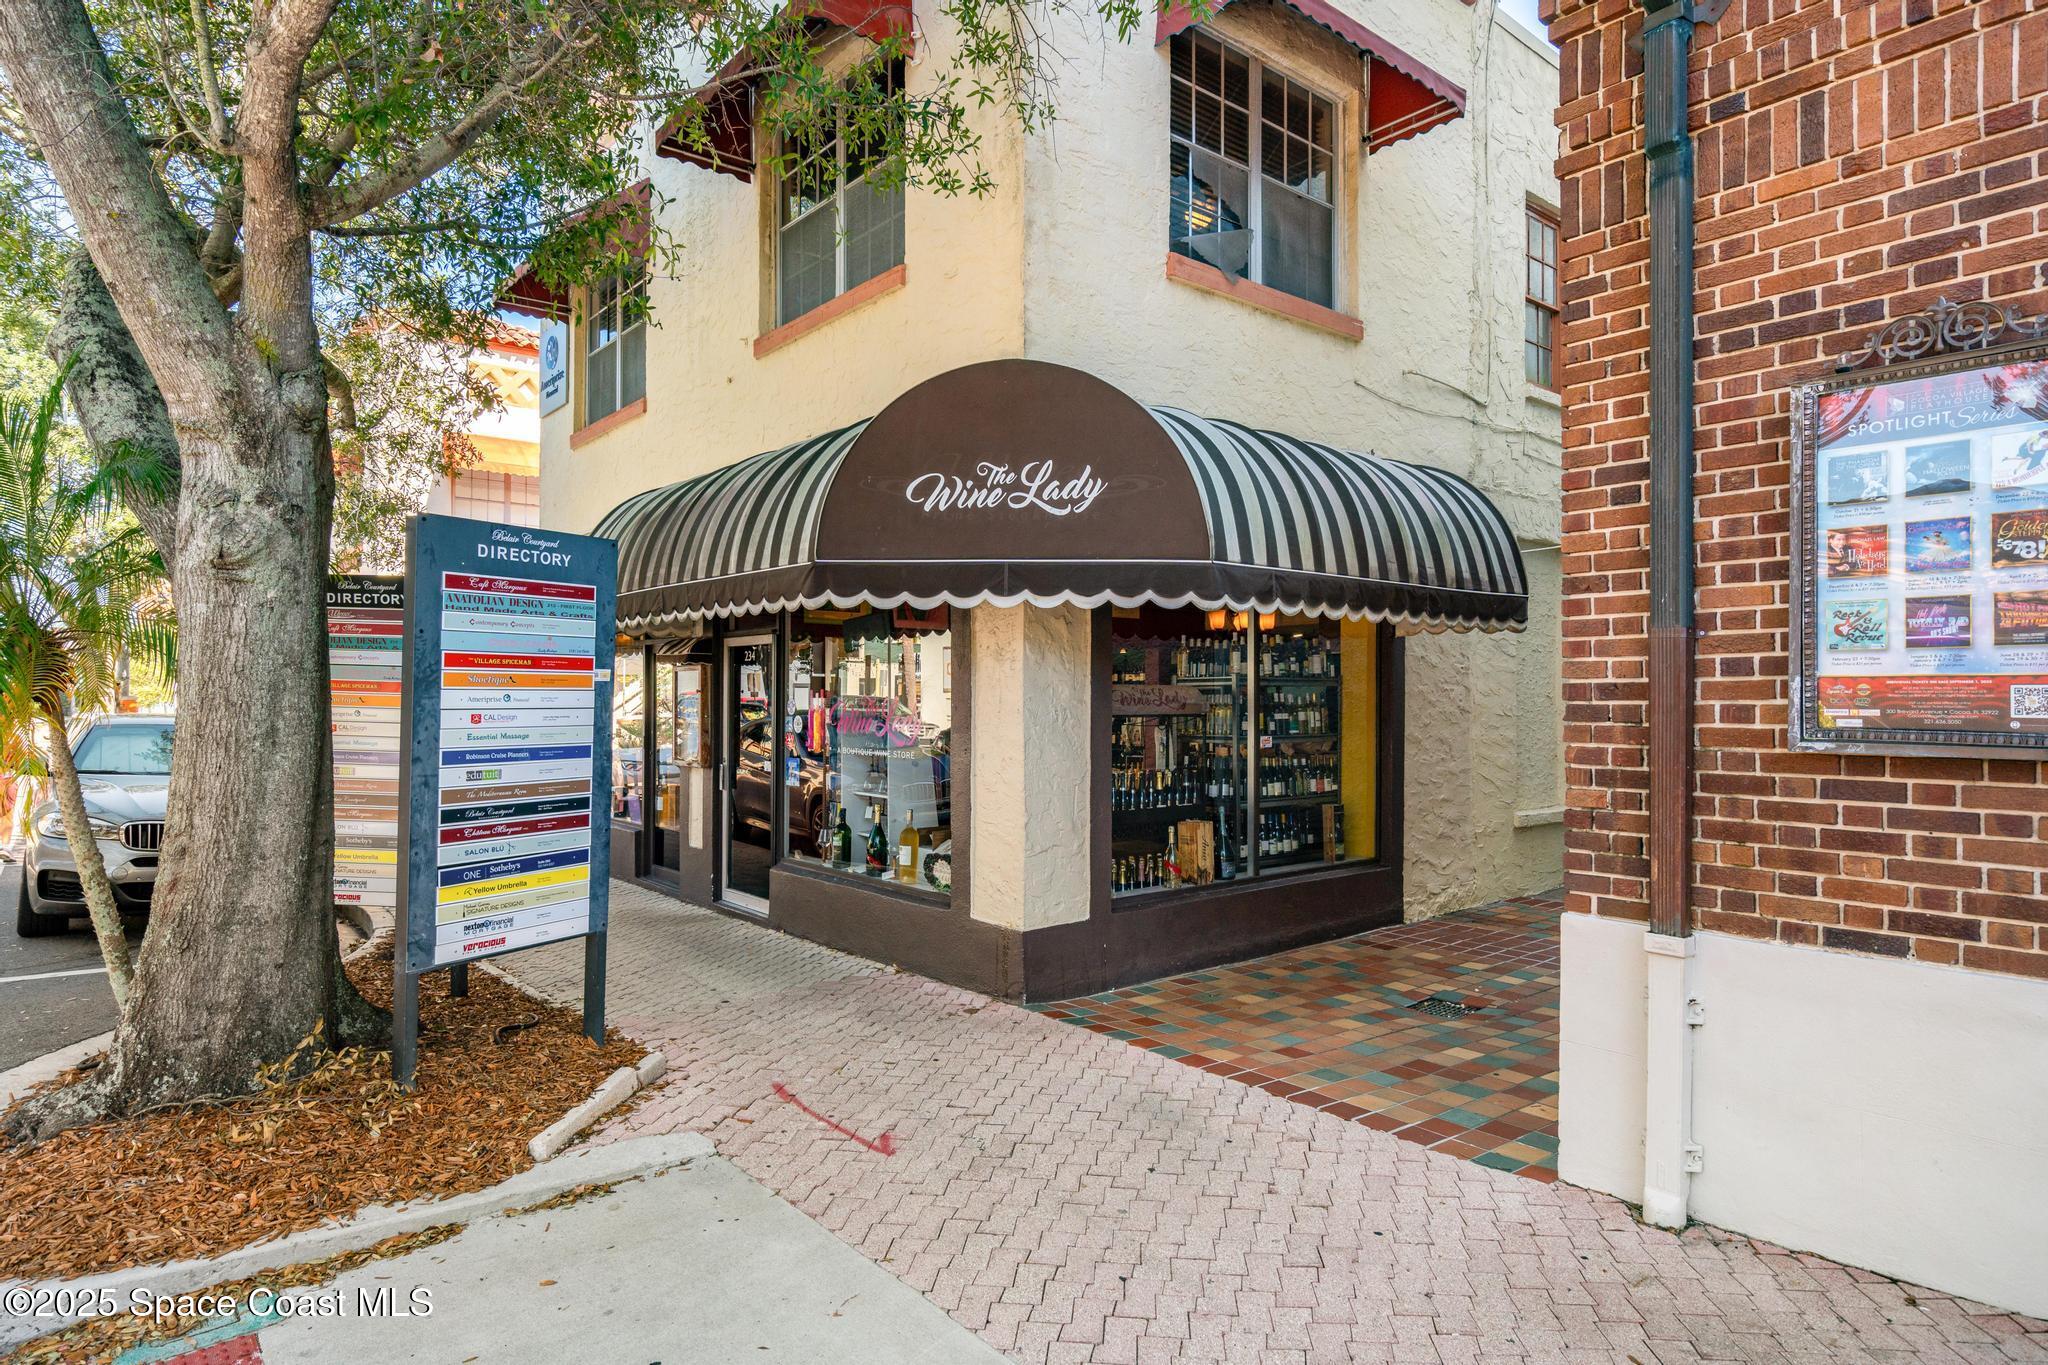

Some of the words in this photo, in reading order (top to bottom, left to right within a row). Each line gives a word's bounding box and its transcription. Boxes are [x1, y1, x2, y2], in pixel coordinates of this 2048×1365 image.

[1950, 386, 1989, 398] VILLAGE
[1910, 394, 1989, 410] PLAYHOUSE
[1848, 410, 1952, 438] SPOTLIGHT
[1949, 405, 2020, 429] Series
[976, 461, 1018, 488] The
[905, 472, 1007, 512] Wine
[1007, 459, 1109, 516] Lady
[491, 529, 519, 543] Belair
[521, 532, 560, 550] Courtyard
[477, 543, 572, 567] DIRECTORY
[337, 580, 361, 590] Belair
[362, 580, 398, 593] Courtyard
[447, 593, 505, 606] ANATOLIAN
[509, 597, 544, 609] DESIGN
[445, 604, 479, 612] Hand
[484, 606, 517, 614] Made
[560, 611, 593, 619] Crafts
[1832, 608, 1863, 620] Rock
[1863, 616, 1873, 625] &
[1853, 622, 1882, 635] Roll
[1907, 616, 1946, 628] TOTALLY
[356, 636, 387, 645] DESIGN
[1845, 632, 1884, 645] Revue
[474, 657, 501, 665] VILLAGE
[744, 650, 756, 662] 234
[467, 695, 503, 704] Ameriprise
[483, 713, 497, 721] CAL
[497, 713, 518, 722] Design
[466, 733, 498, 741] Essential
[500, 732, 530, 740] Massage
[842, 747, 874, 757] BOUTIQUE
[892, 750, 916, 760] STORE
[464, 847, 489, 856] SALON
[491, 845, 504, 853] BLU
[463, 869, 481, 880] ONE
[474, 886, 496, 895] Yellow
[497, 881, 528, 890] Umbrella
[464, 923, 514, 936] MORTGAGE
